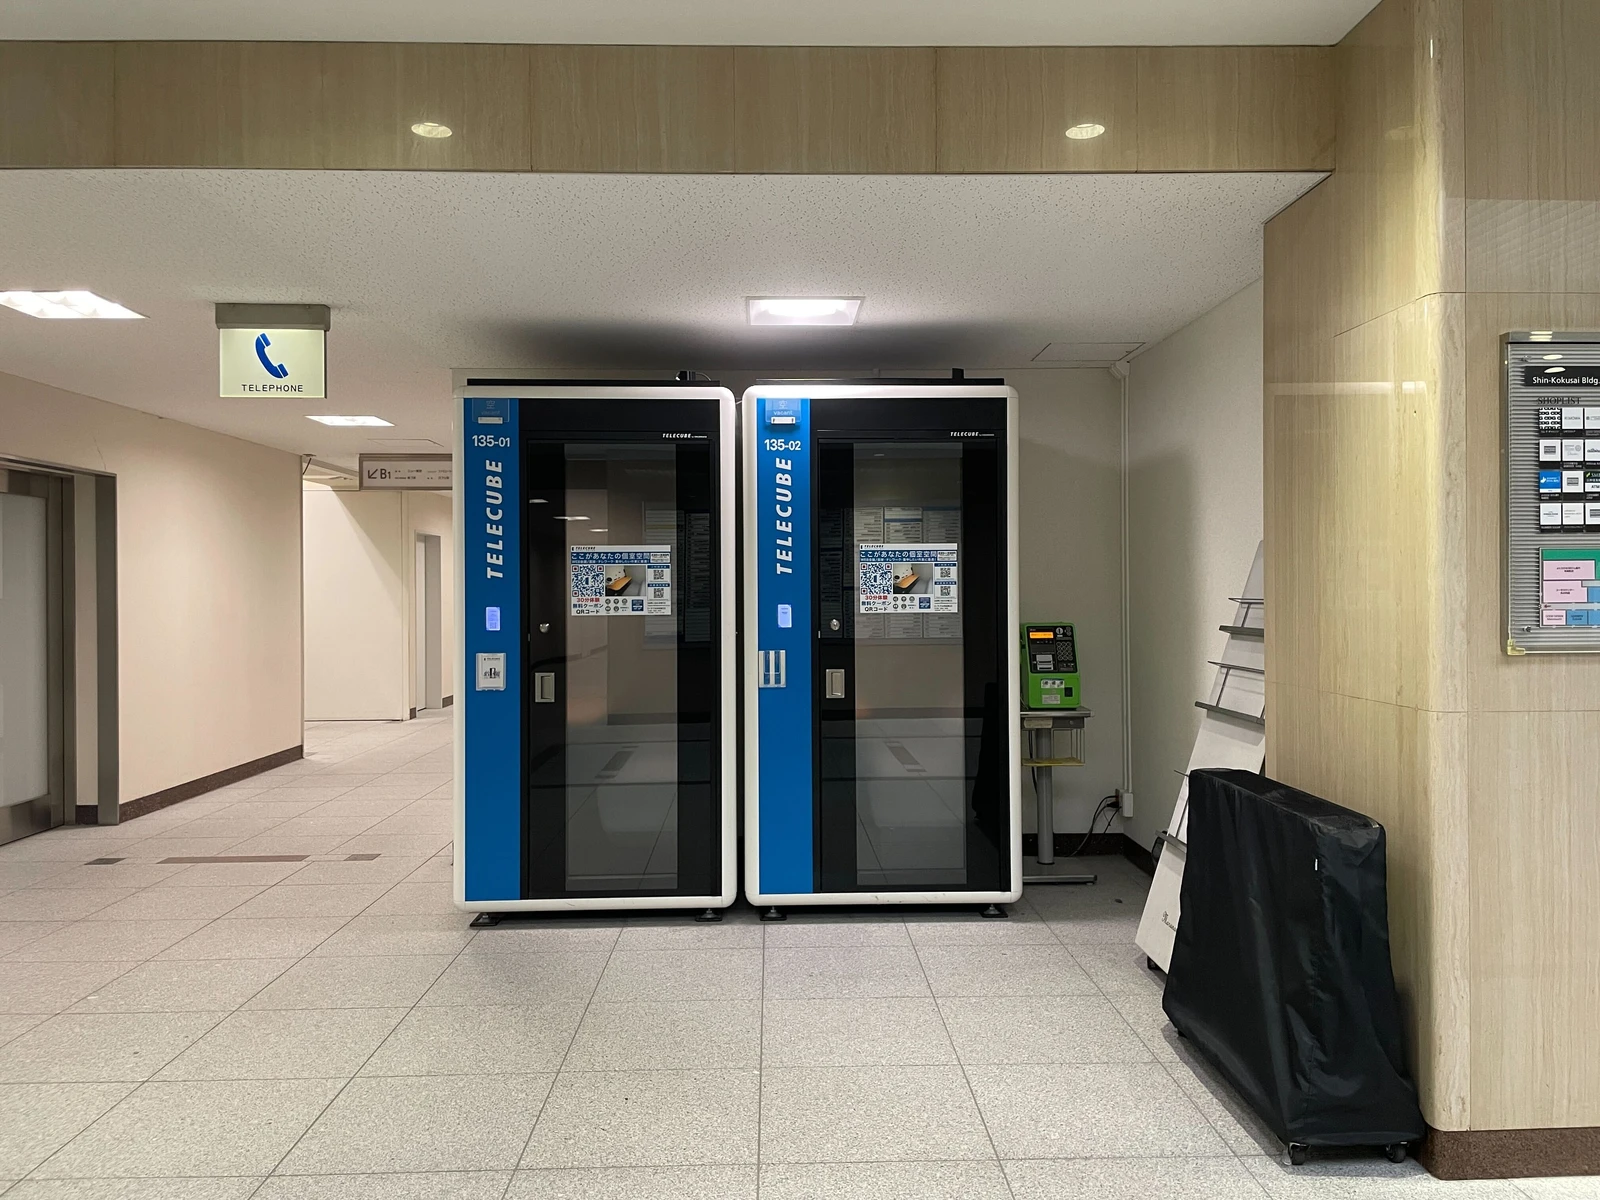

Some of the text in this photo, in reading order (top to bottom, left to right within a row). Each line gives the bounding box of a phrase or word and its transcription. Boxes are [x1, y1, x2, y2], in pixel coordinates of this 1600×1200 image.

[1532, 376, 1600, 386] Shin-Kokusai Bldg.
[241, 384, 303, 392] TELEPHONE
[472, 434, 510, 448] 135-01
[764, 438, 801, 451] 135-02
[380, 468, 391, 479] B1
[485, 459, 504, 579] TELECUBE
[775, 457, 793, 575] TELECUBE
[571, 552, 650, 560] ここがあなたの個室空間
[860, 550, 937, 558] ここがあなたの個室空間
